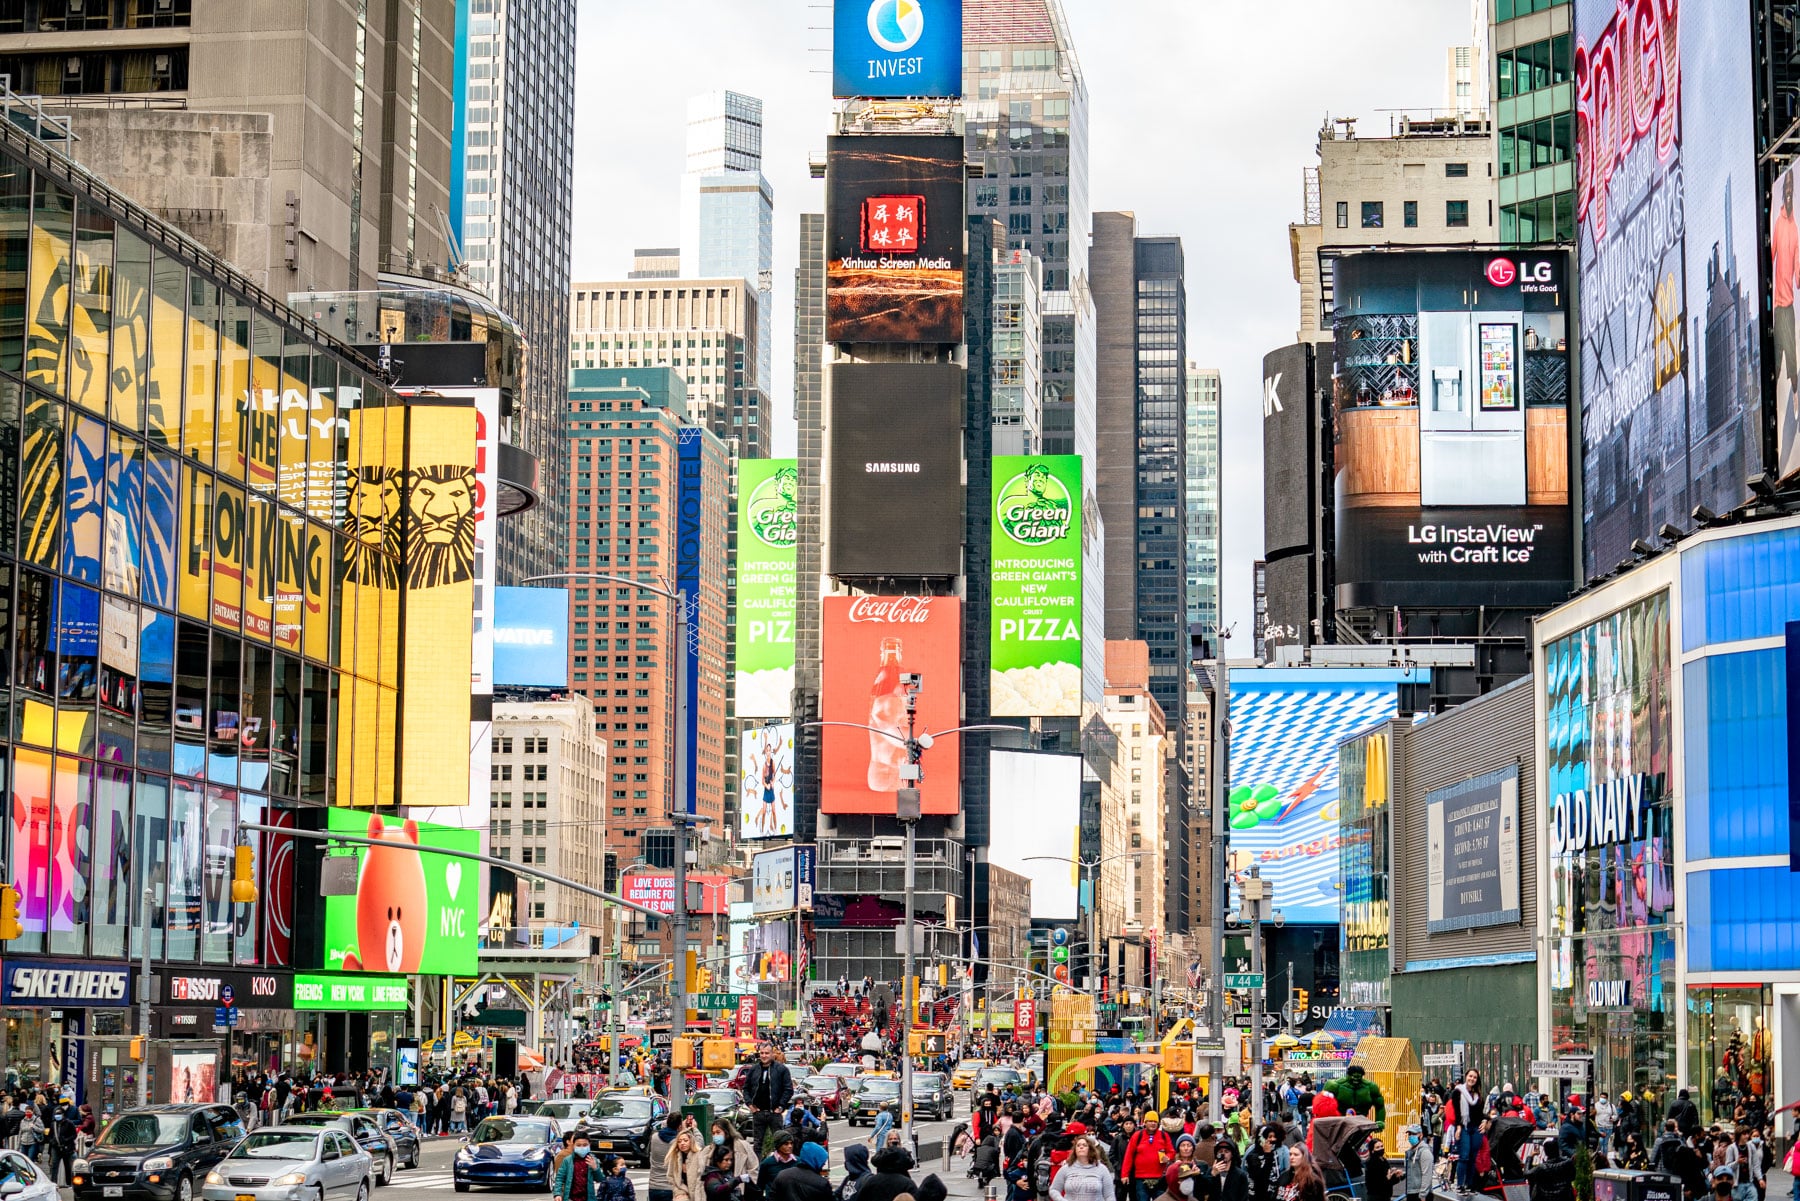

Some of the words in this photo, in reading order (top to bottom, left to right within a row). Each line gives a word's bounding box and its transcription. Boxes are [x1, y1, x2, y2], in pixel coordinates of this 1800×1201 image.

[867, 57, 923, 79] INVEST
[841, 257, 877, 270] Xinhua
[879, 257, 916, 270] Screen
[918, 257, 951, 270] Media
[1520, 262, 1552, 282] LG
[1520, 284, 1538, 293] Life's
[1539, 284, 1558, 292] Good
[236, 399, 276, 468] THE
[865, 462, 920, 474] SAMSUNG
[678, 446, 701, 582] NOVOTEL
[1006, 504, 1067, 522] Green
[189, 467, 256, 577] LION
[258, 501, 322, 601] KING
[1013, 522, 1069, 539] Giant
[1408, 525, 1437, 543] LG
[1418, 550, 1447, 563] with
[1450, 546, 1499, 563] Craft
[744, 561, 797, 571] INTRODU
[994, 558, 1075, 569] INTRODUCING
[742, 574, 779, 584] GREEN
[991, 571, 1030, 581] GREEN
[1032, 571, 1077, 581] GIANT'S
[770, 586, 796, 596] NEW
[1021, 584, 1047, 594] NEW
[994, 596, 1075, 607] CAULIFLOWER
[214, 603, 241, 622] ENTRANCE
[246, 616, 255, 628] ON
[256, 618, 270, 632] 45TH
[749, 620, 796, 643] PIZ
[1000, 618, 1081, 641] PIZZA
[1554, 789, 1588, 853] OLD
[1591, 772, 1646, 849] NAVY
[634, 878, 652, 888] LOVE
[630, 889, 661, 899] REQUIRE
[651, 901, 658, 910] IS
[441, 906, 465, 938] NYC
[10, 968, 129, 999] SKECHERS
[252, 977, 276, 996] KIKO
[1227, 976, 1234, 986] W
[1238, 976, 1251, 986] 44
[296, 984, 323, 1000] FRIENDS
[331, 985, 347, 1001] NEW
[348, 985, 365, 1001] YORK
[1589, 981, 1604, 1007] OLD
[1604, 980, 1627, 1006] NAVY
[700, 997, 709, 1006] W
[714, 997, 727, 1006] 44
[742, 998, 754, 1024] tkts
[1019, 1002, 1032, 1027] tkts
